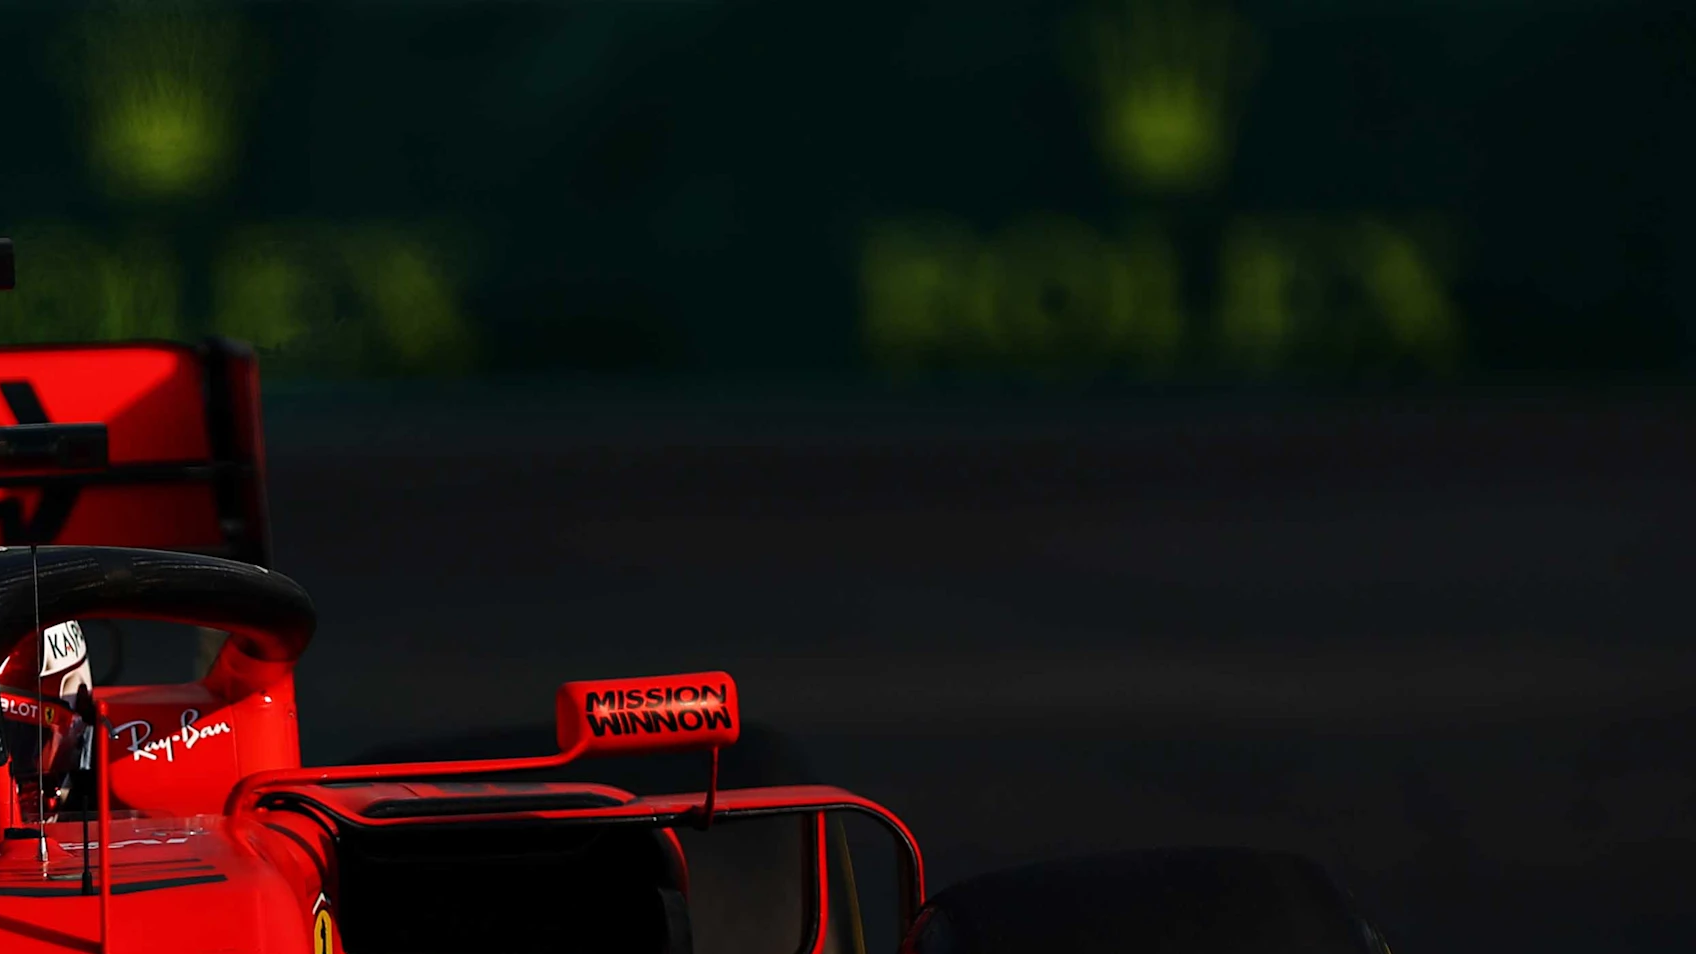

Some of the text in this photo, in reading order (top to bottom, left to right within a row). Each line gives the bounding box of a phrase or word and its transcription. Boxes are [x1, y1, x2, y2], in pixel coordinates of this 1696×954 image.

[585, 684, 726, 712] MISSION
[110, 708, 231, 762] Ray-Ban
[587, 706, 732, 737] WINNOW
